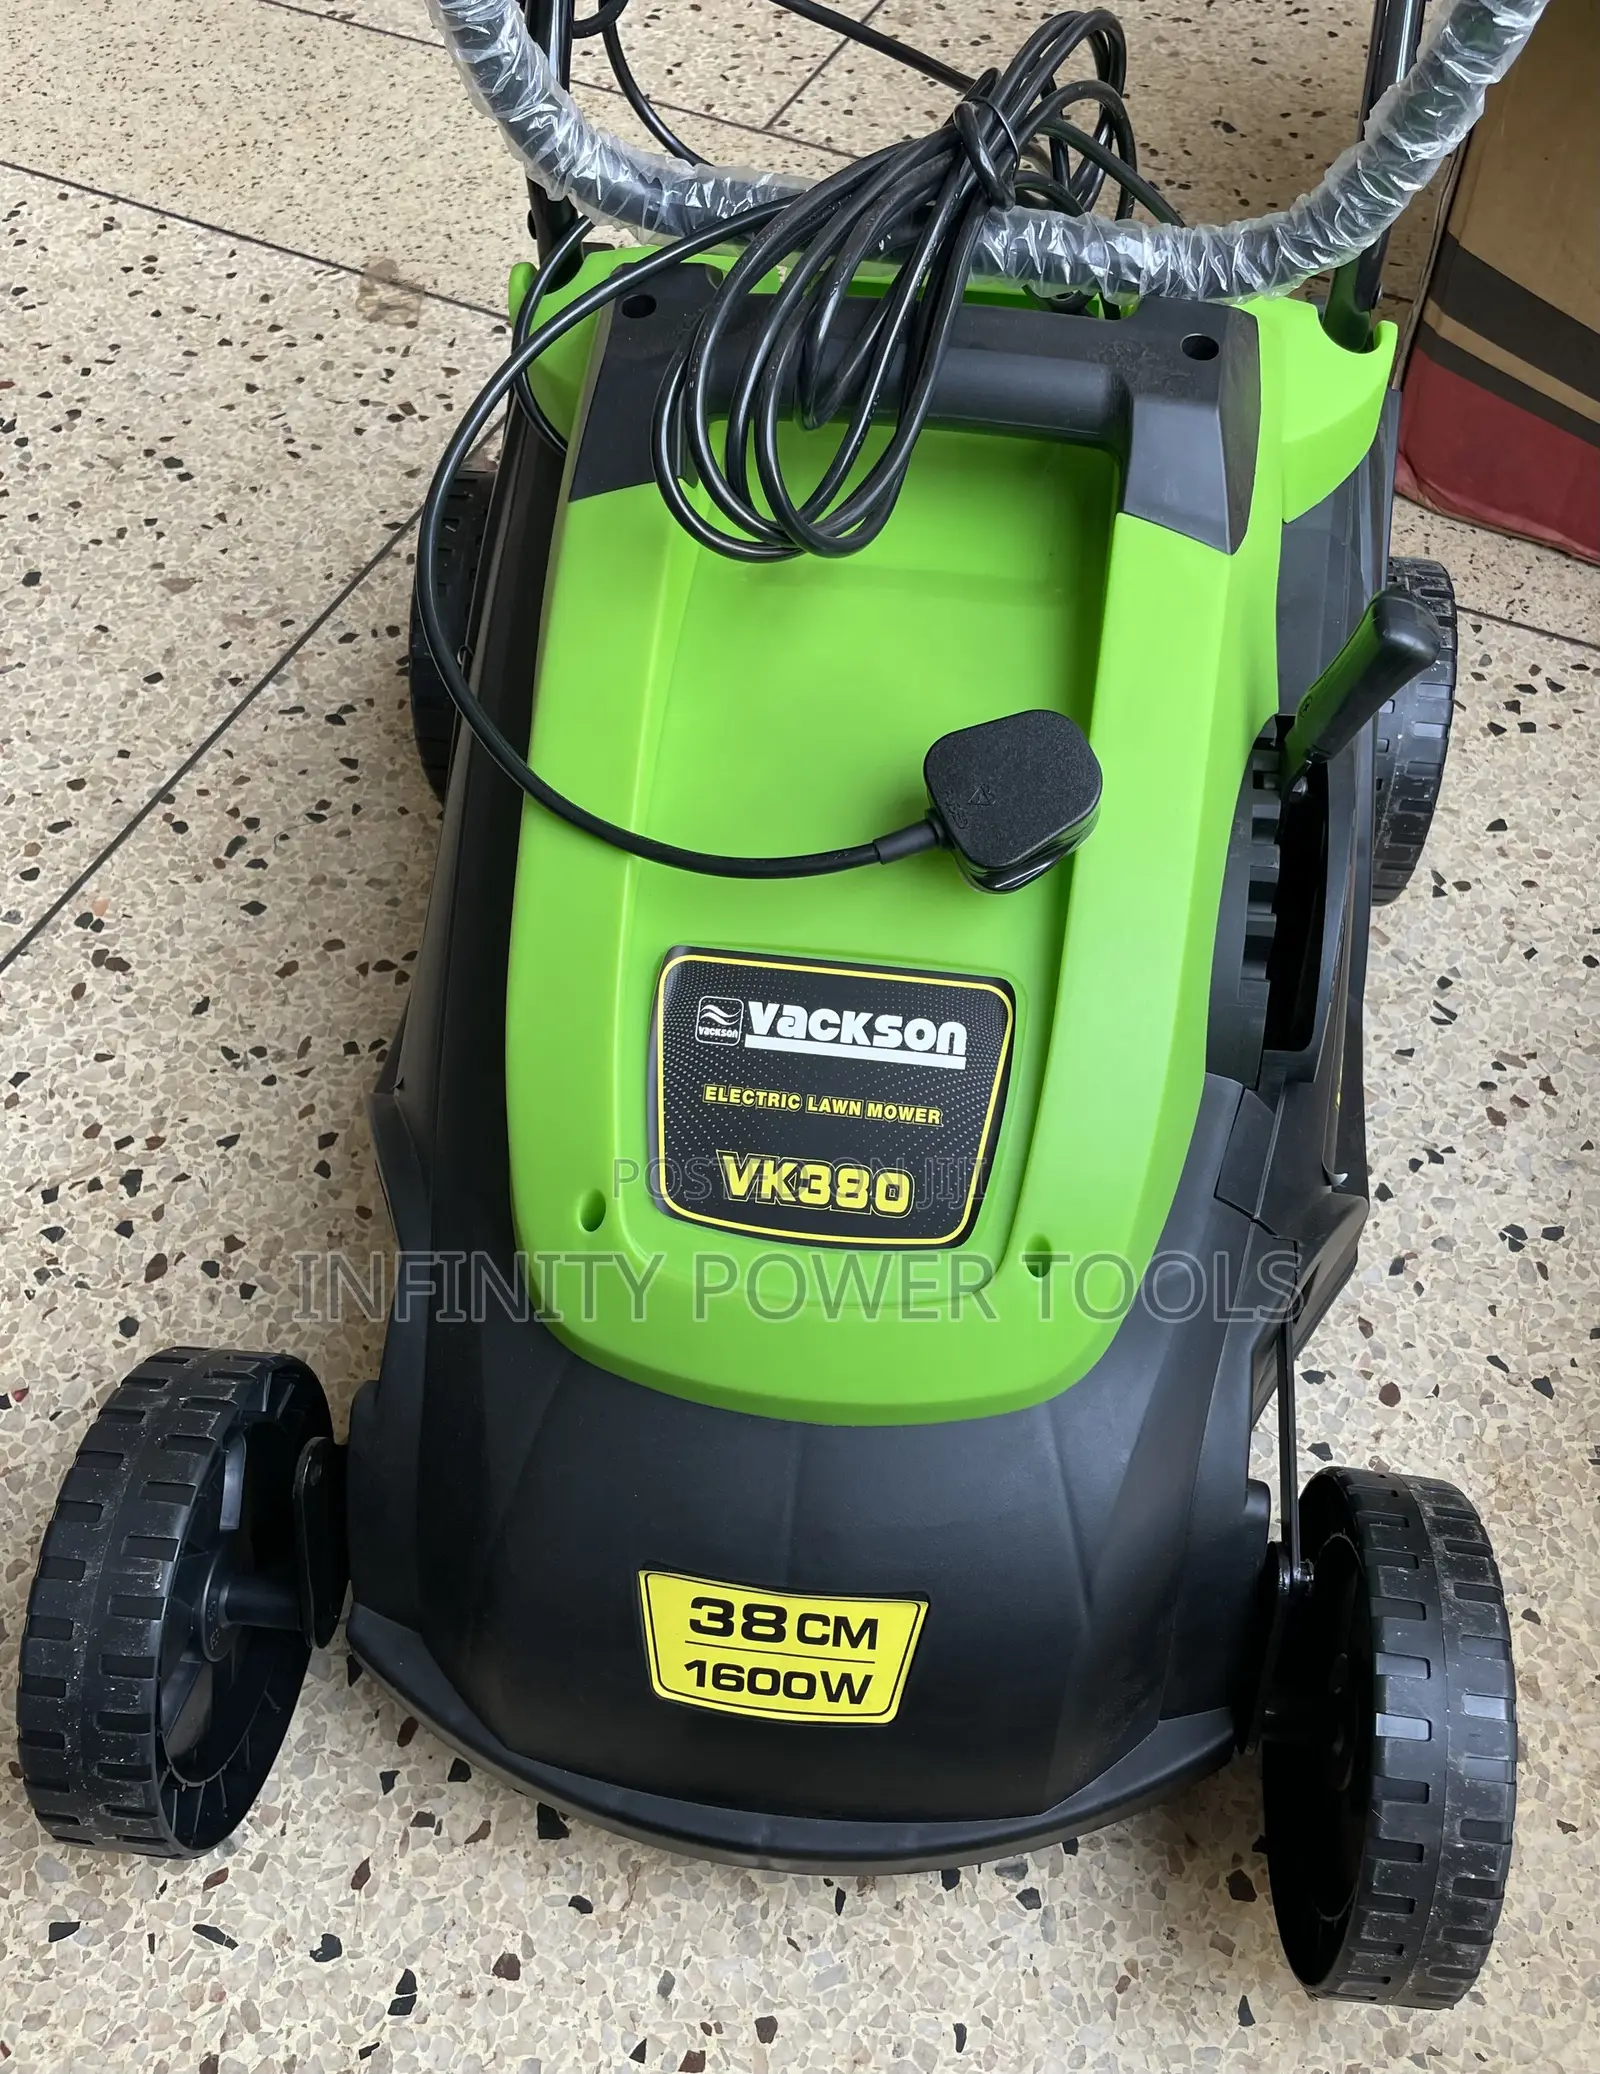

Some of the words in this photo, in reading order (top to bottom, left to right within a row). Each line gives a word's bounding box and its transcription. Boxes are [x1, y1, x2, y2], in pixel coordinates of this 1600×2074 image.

[703, 1085, 801, 1111] ELECTRIC
[807, 1096, 862, 1117] LAWN
[866, 1102, 943, 1126] MOWER
[717, 1151, 914, 1218] VK380
[688, 1596, 788, 1644] 38
[796, 1612, 879, 1651] CM
[683, 1659, 874, 1705] 1600W
